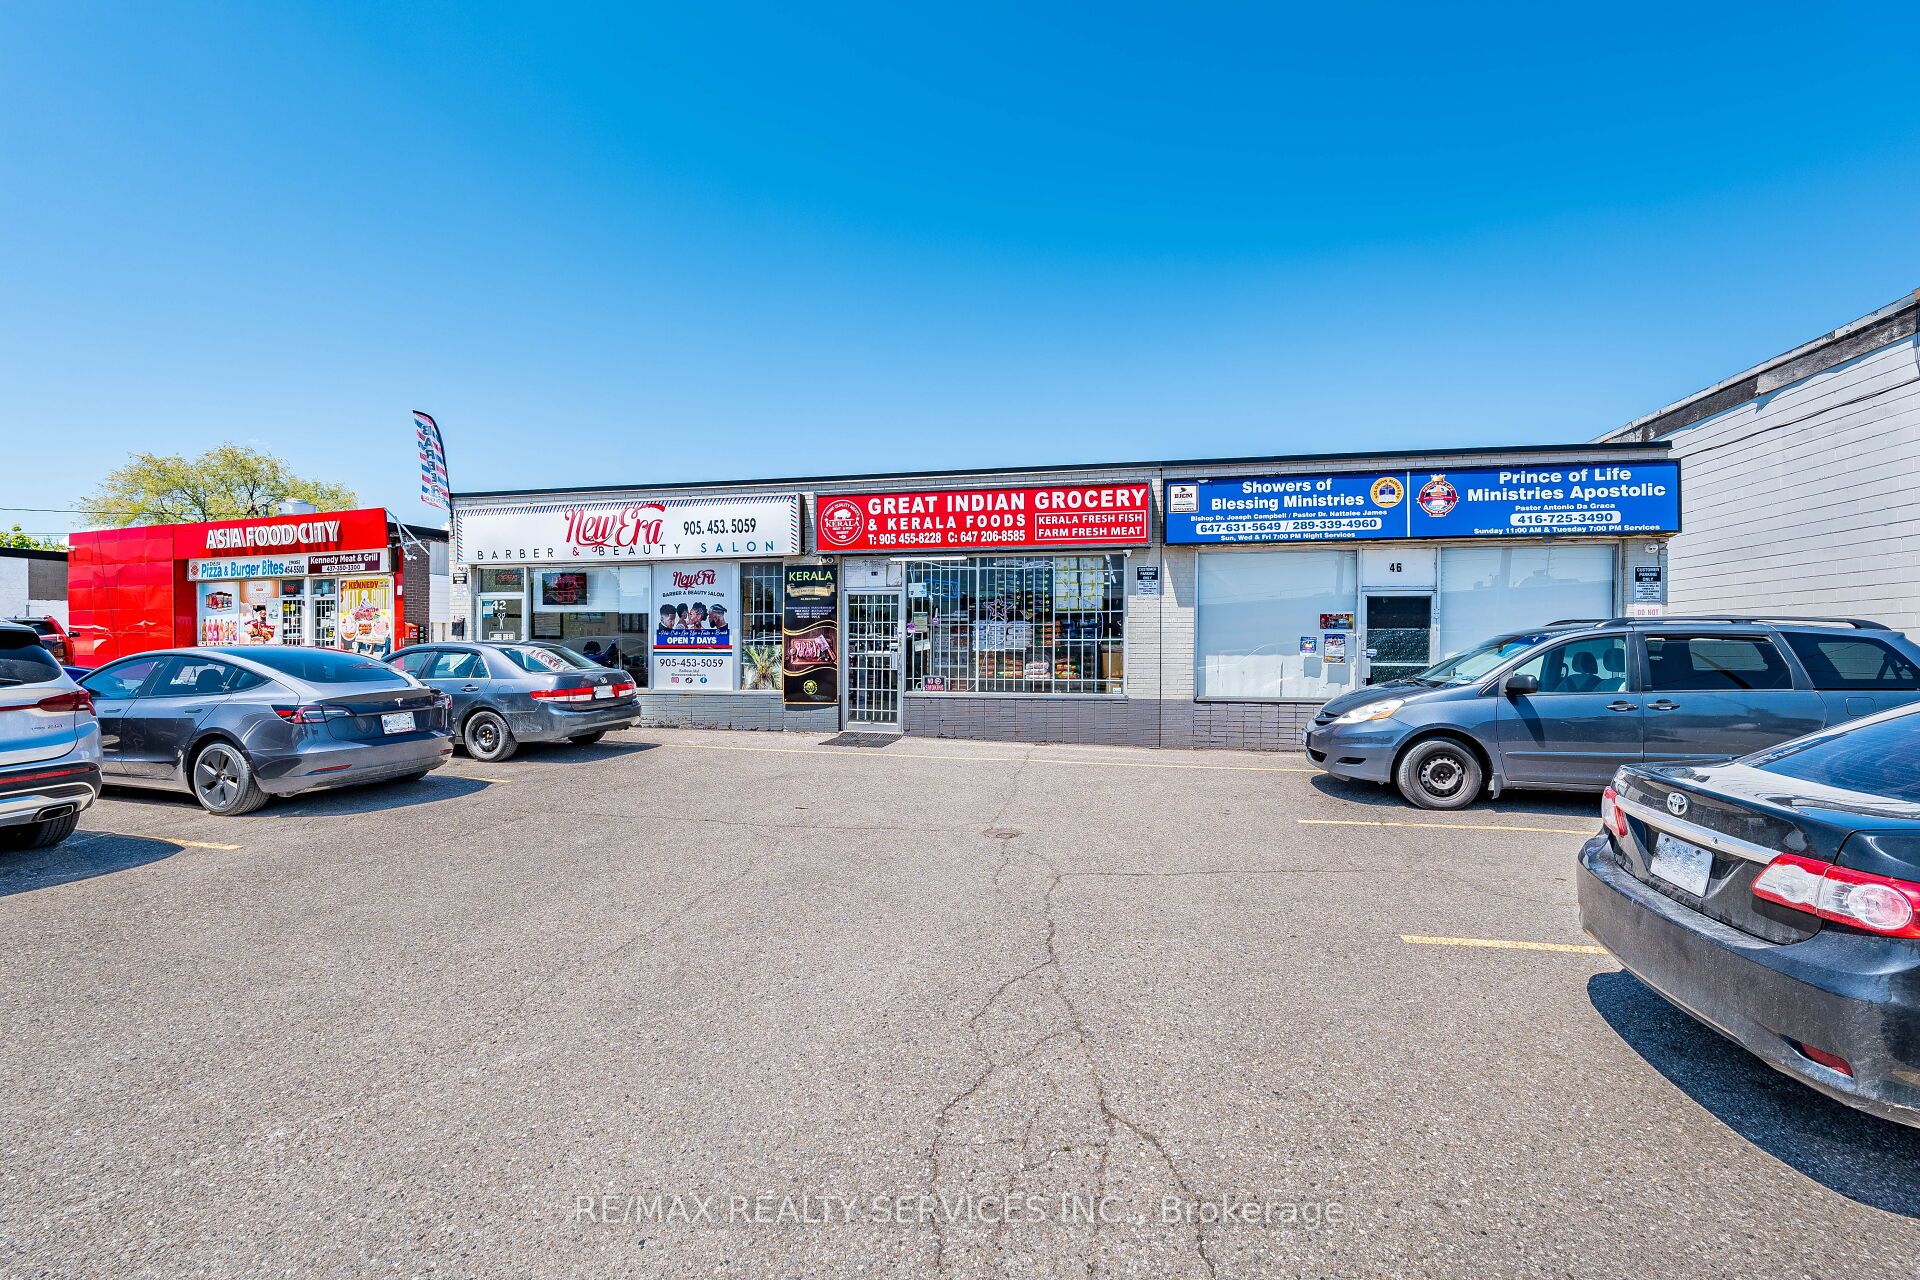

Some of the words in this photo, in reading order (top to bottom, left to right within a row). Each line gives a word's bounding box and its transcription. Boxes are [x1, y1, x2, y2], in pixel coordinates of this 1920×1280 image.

[1499, 471, 1563, 484] Prince
[1568, 468, 1588, 482] of
[1594, 467, 1632, 480] Life
[1242, 480, 1312, 494] Showers
[1316, 478, 1333, 491] of
[1467, 486, 1564, 502] Ministries
[1570, 483, 1666, 501] Apostolic
[868, 496, 938, 515] GREAT
[946, 492, 1025, 512] INDIAN
[1034, 488, 1146, 510] GROCERY
[1211, 496, 1279, 512] Blessing
[1283, 494, 1365, 508] Ministries
[868, 518, 878, 531] &
[887, 516, 957, 530] KERALA
[966, 514, 1026, 528] FOODS
[1038, 516, 1079, 524] KERALA
[1082, 514, 1115, 524] FRESH
[1118, 514, 1142, 522] FISH
[1517, 512, 1613, 524] 416-725-3490
[731, 518, 757, 534] 5059
[1038, 528, 1068, 537] FARM
[1072, 527, 1107, 536] FRESH
[1110, 526, 1142, 536] MEAT
[1200, 522, 1281, 533] 647-631-5649
[1284, 522, 1289, 532] /
[1292, 519, 1377, 530] 289-339-4960
[206, 528, 247, 549] ASIA
[246, 524, 298, 547] FOOD
[298, 520, 340, 544] CITY
[868, 534, 877, 545] T:
[878, 533, 896, 544] 905
[898, 532, 942, 544] 455-8228
[948, 532, 958, 542] C:
[960, 531, 978, 542] 647
[980, 530, 1026, 542] 206-8585
[477, 548, 554, 560] BARBER
[572, 546, 580, 557] &
[599, 544, 681, 556] BEAUTY
[700, 540, 775, 553] SALON
[310, 556, 339, 564] Kennedy
[340, 554, 356, 562] Meat
[364, 552, 378, 562] Grill
[201, 564, 222, 578] Pizza
[224, 565, 230, 576] &
[231, 562, 260, 578] Burger
[262, 560, 284, 576] Bites
[1389, 562, 1402, 573] 46
[788, 570, 833, 582] KERALA
[348, 580, 378, 590] KENNEDY
[492, 600, 507, 610] 42
[666, 636, 688, 644] OPEN
[696, 636, 717, 644] DAYS
[660, 658, 724, 668] 905-453-5059
